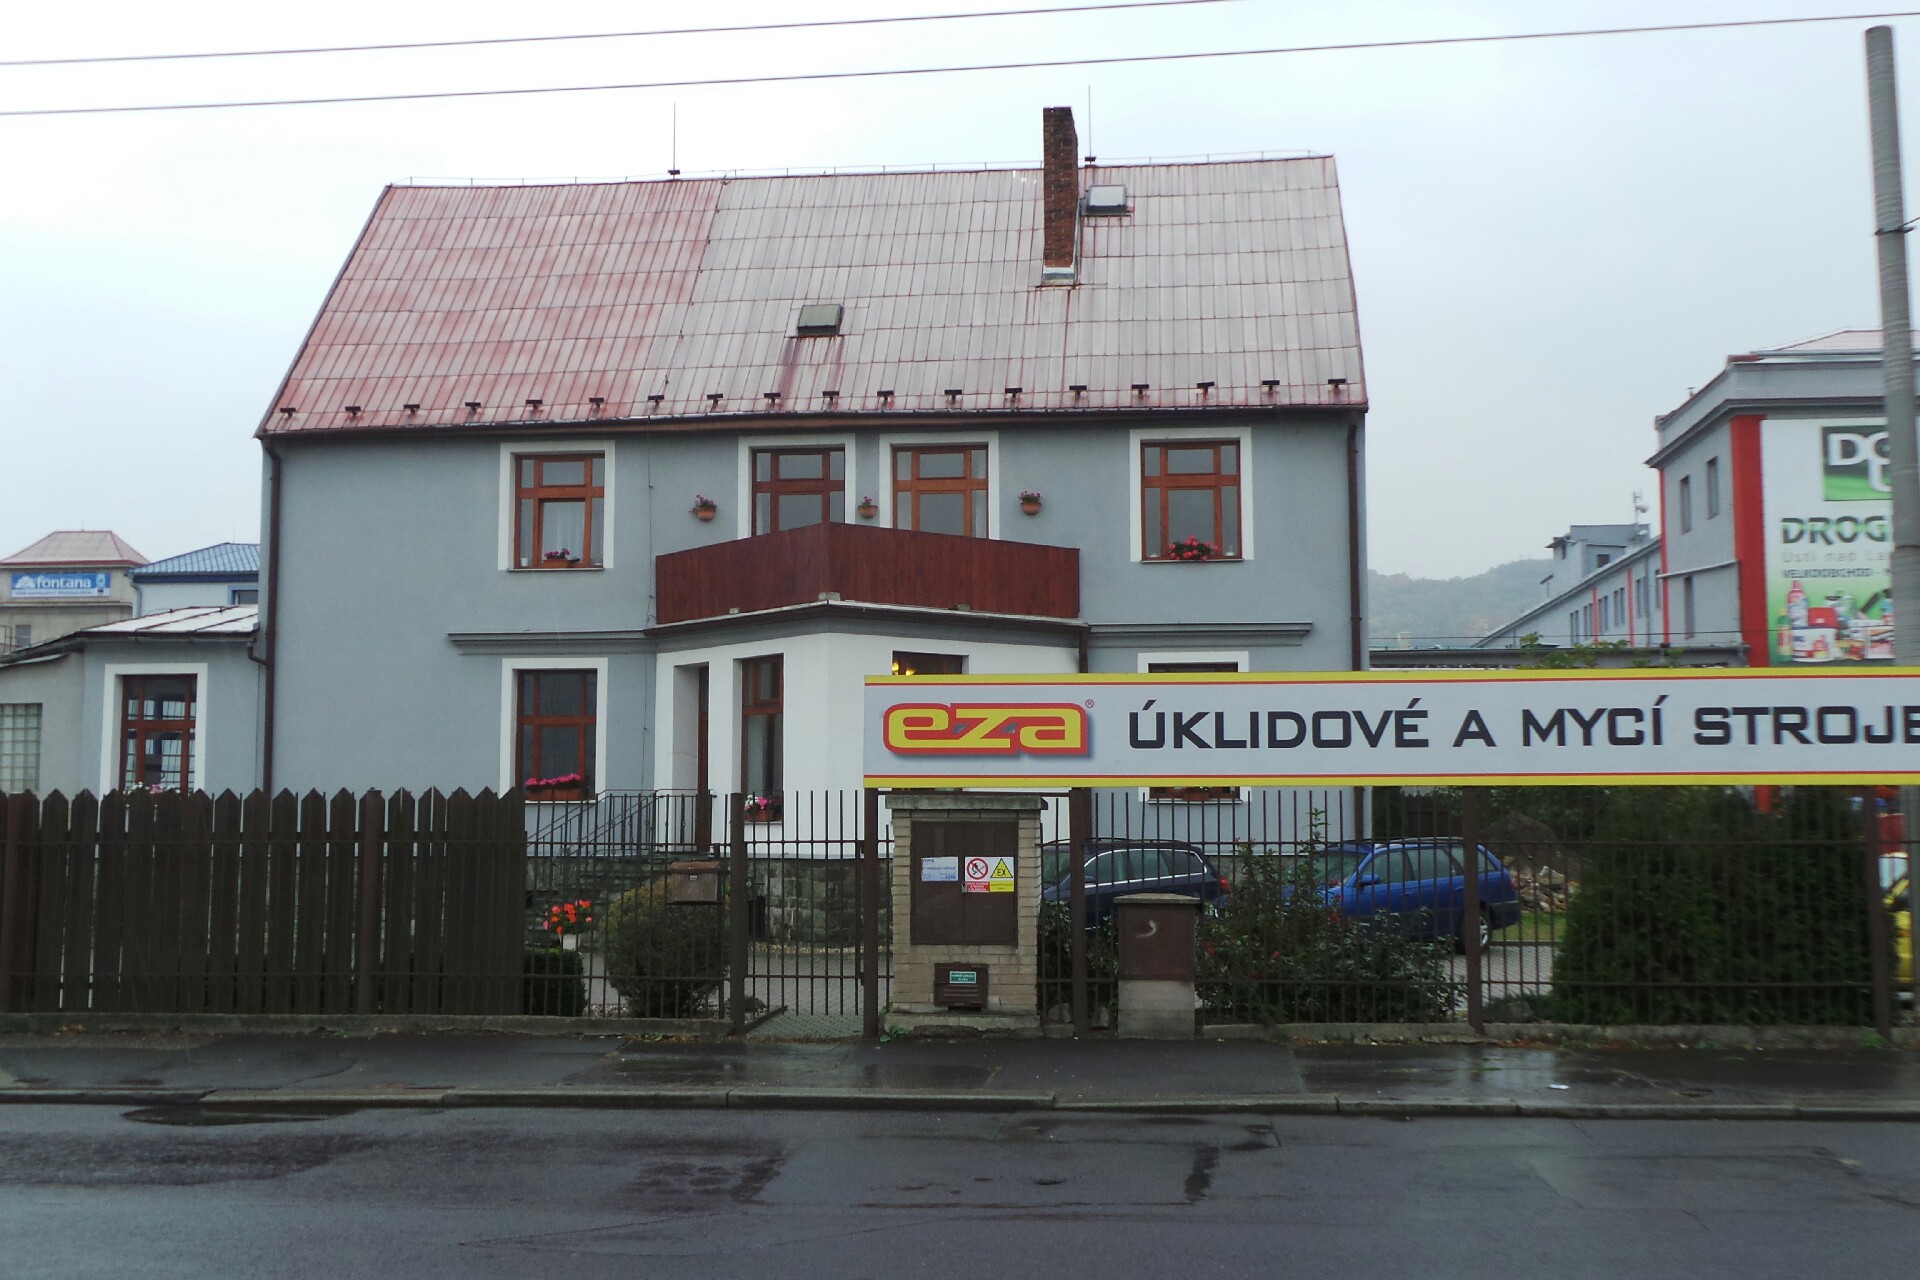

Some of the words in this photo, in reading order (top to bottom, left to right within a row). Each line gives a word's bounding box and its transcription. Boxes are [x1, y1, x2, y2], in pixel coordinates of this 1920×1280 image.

[1781, 516, 1888, 545] DROG
[1864, 549, 1887, 562] La
[37, 574, 92, 589] fontana
[888, 708, 1081, 748] eza
[1129, 697, 1429, 749] ÚKLIDOVÉ
[1453, 709, 1497, 748] A
[1523, 694, 1668, 747] MYCÍ
[997, 868, 1007, 877] EX
